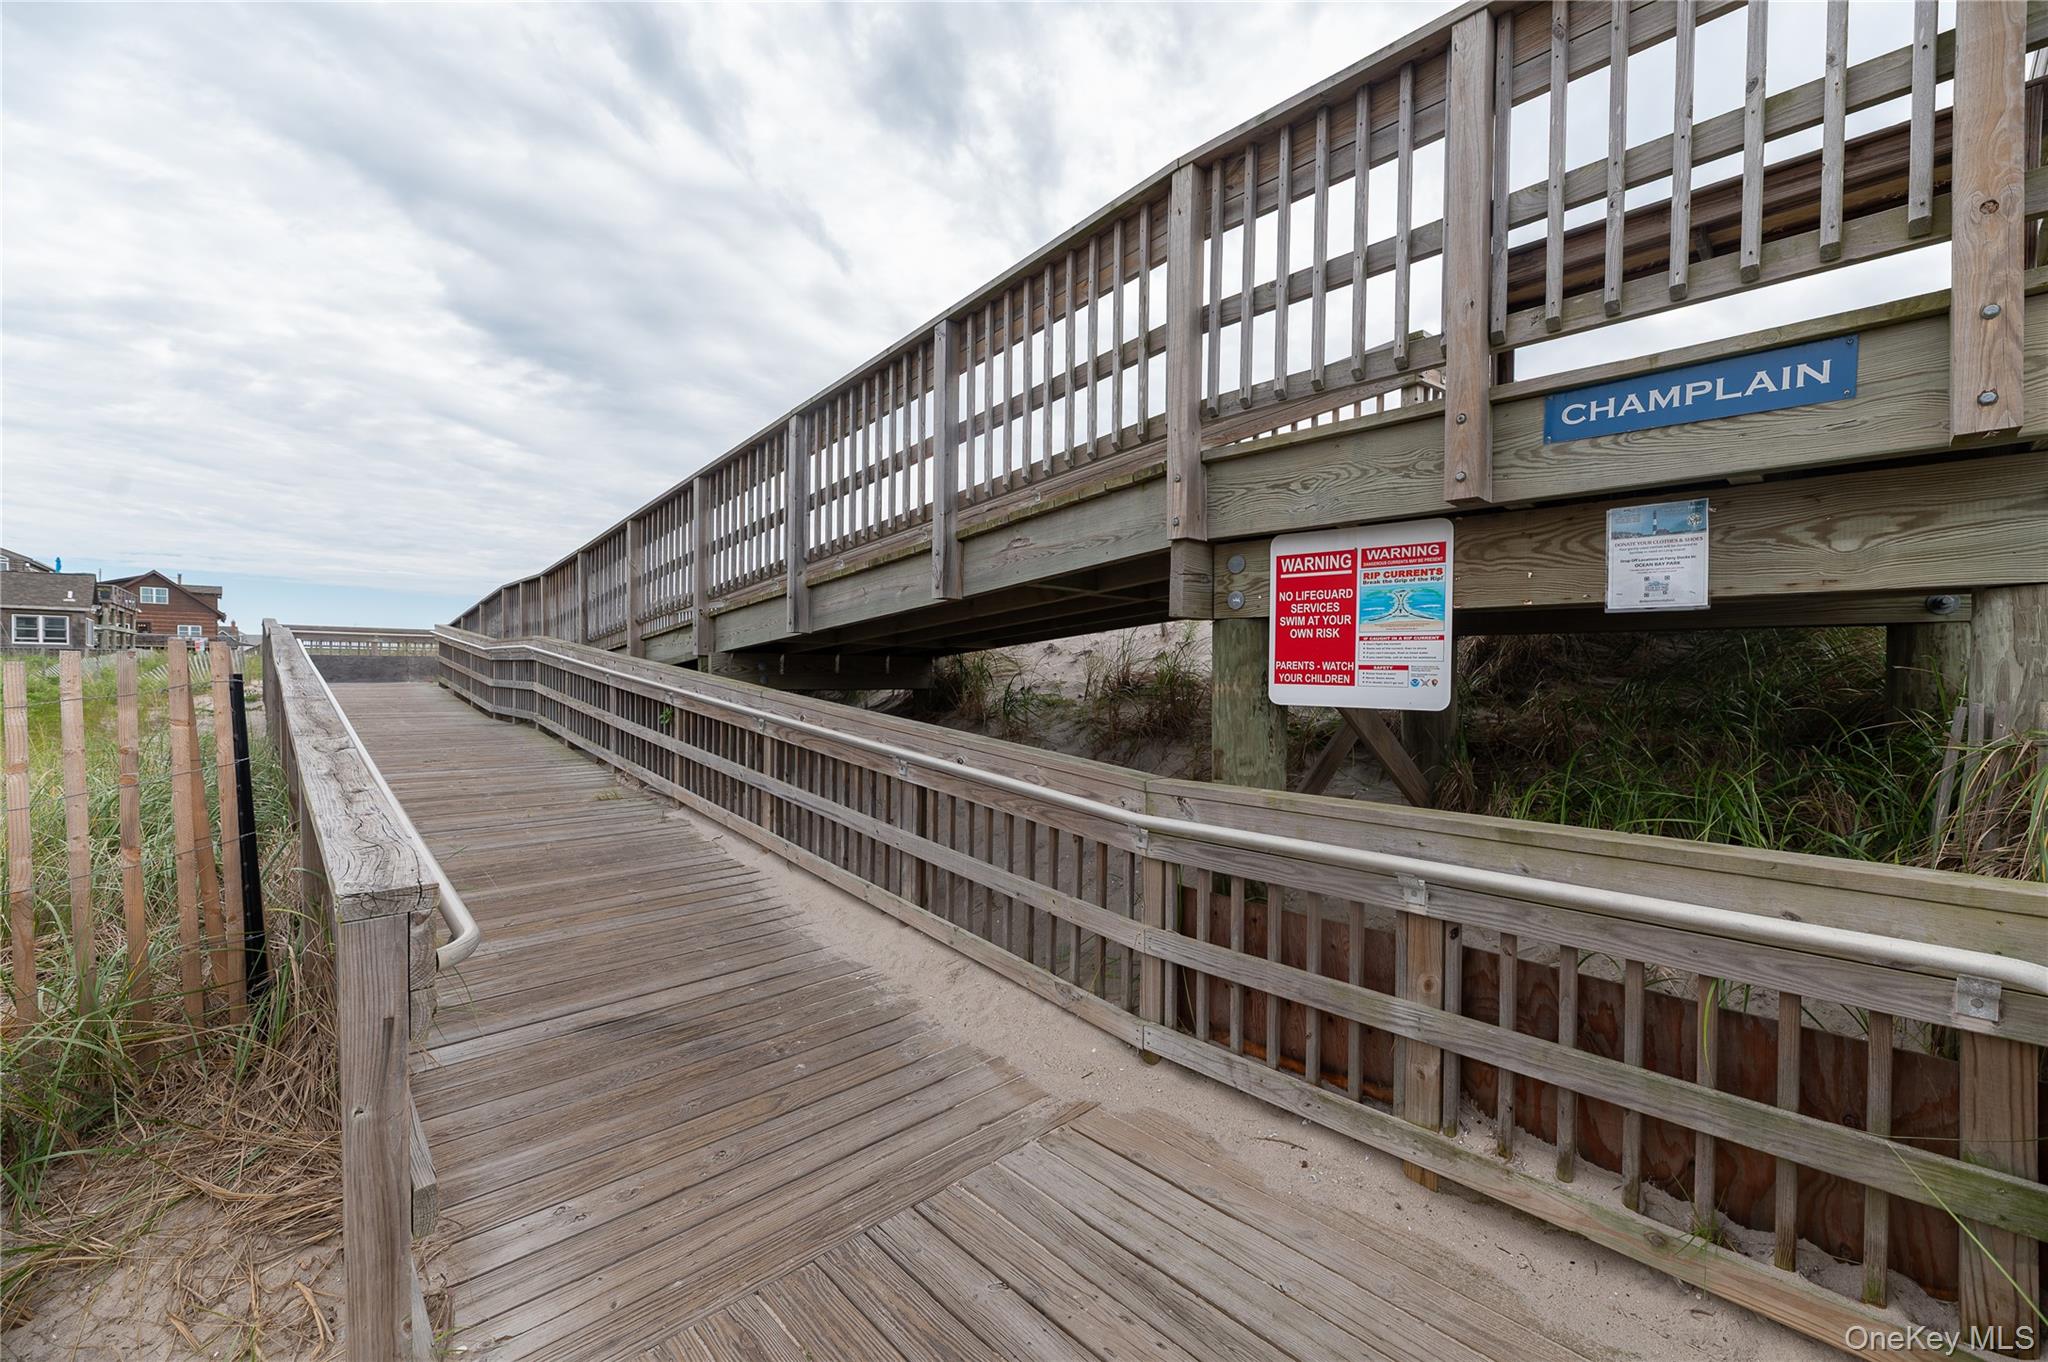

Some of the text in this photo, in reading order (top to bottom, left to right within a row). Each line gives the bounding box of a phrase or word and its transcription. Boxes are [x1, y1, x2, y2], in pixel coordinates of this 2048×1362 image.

[1561, 359, 1833, 426] CHAMPLAIN
[1366, 544, 1440, 561] WARNING
[1280, 553, 1353, 573] WARNING
[1362, 568, 1443, 580] RIP CURRENTS
[1279, 588, 1353, 601] NO LIFEGUARD
[1290, 602, 1340, 614] SERVICES
[1279, 614, 1352, 626] SWIM AT YOUR
[1289, 627, 1340, 639] OWN RISK
[1275, 661, 1316, 670] PARENTS
[1322, 661, 1354, 671] WATCH
[1278, 673, 1350, 684] YOUR CHILDREN
